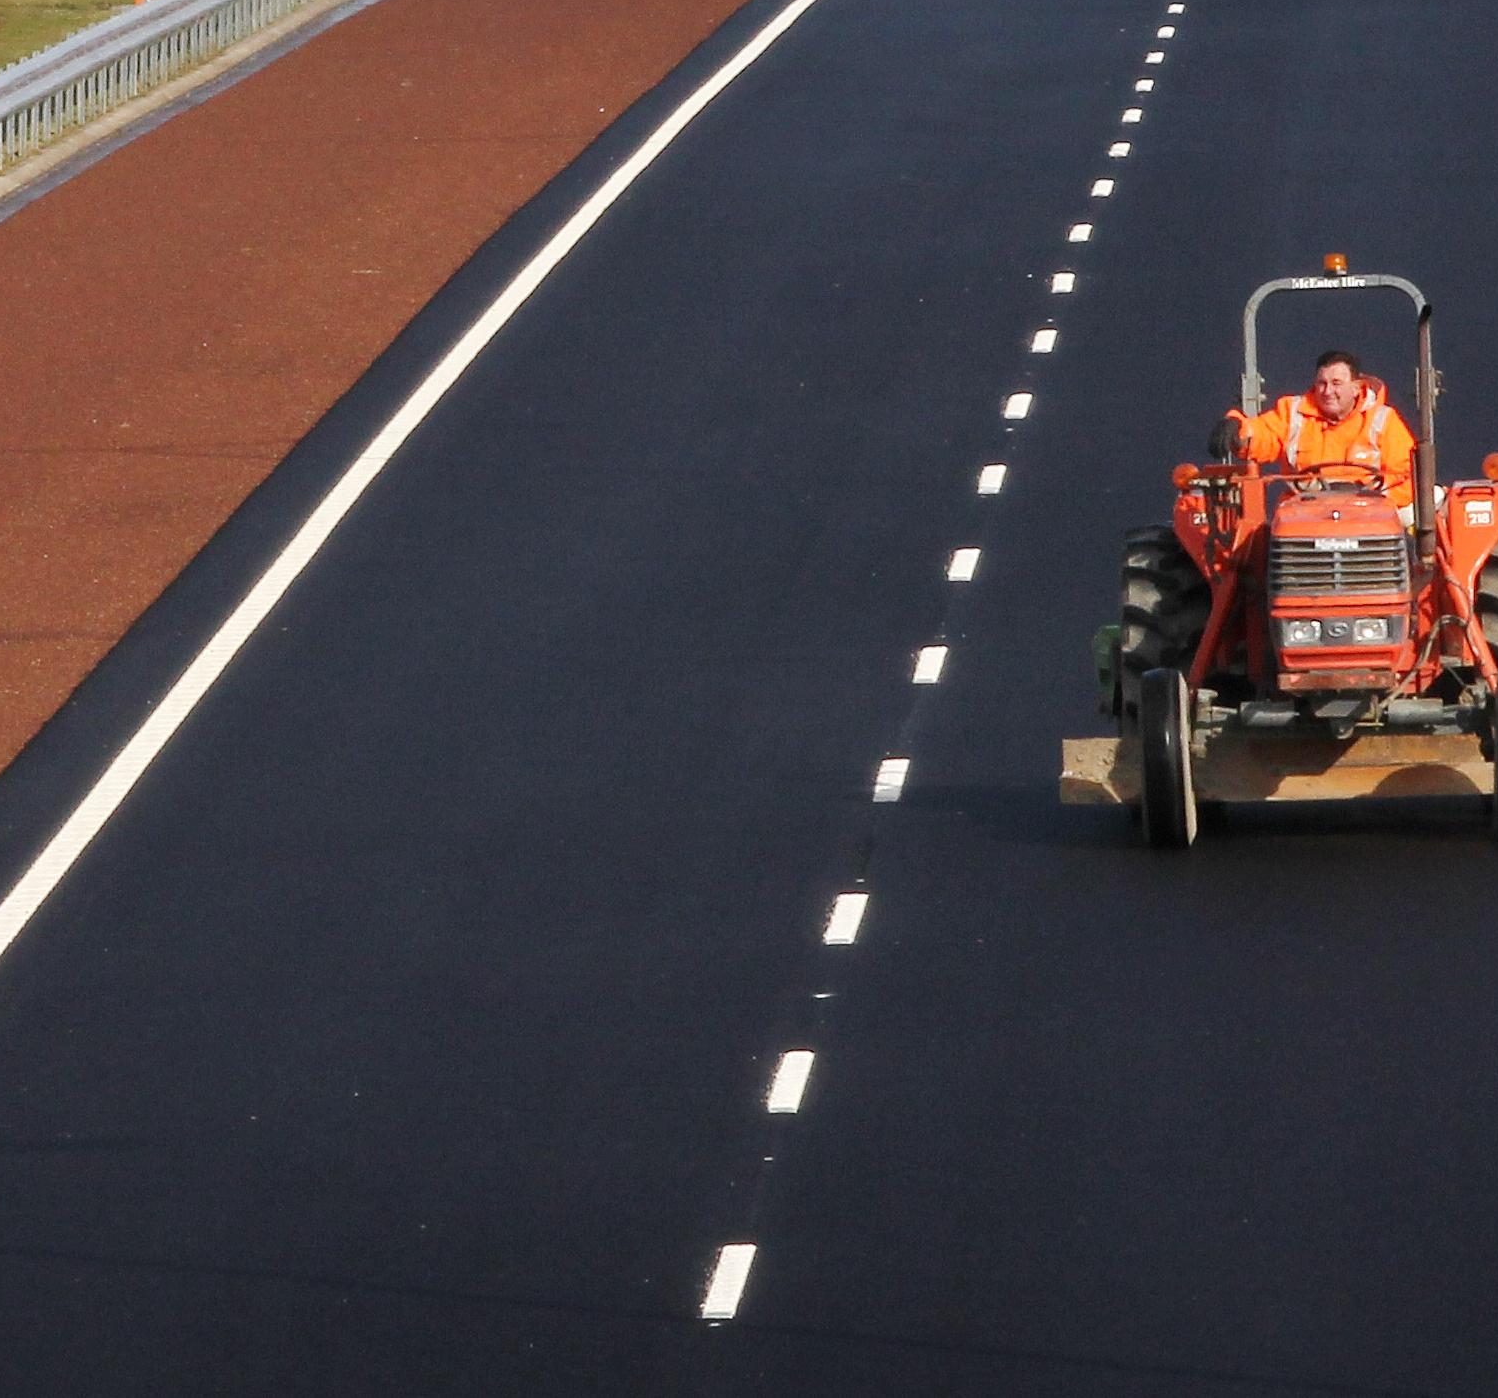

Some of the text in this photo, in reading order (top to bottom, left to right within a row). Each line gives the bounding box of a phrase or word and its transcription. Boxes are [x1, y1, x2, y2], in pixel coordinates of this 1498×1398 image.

[1291, 276, 1366, 289] McEntee Hire
[1468, 512, 1491, 525] 218
